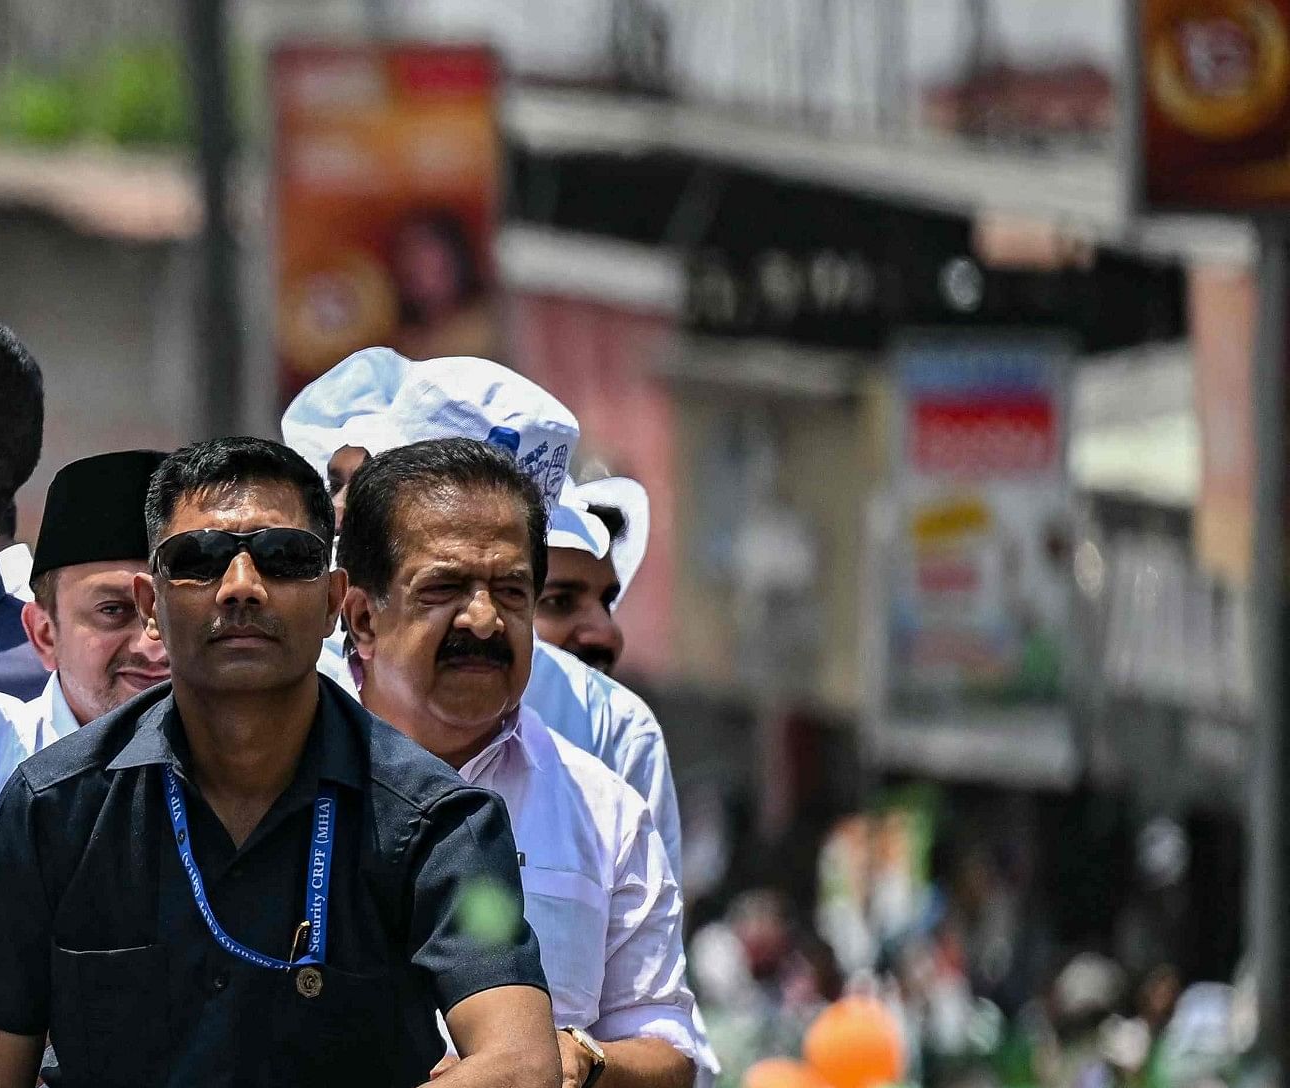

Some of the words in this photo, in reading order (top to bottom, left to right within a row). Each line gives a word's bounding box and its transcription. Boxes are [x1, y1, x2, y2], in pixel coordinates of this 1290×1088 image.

[170, 796, 182, 822] VIP
[314, 797, 333, 844] (MHA)
[311, 848, 326, 889] CRPF
[309, 893, 326, 953] Security
[219, 935, 272, 967] Security
